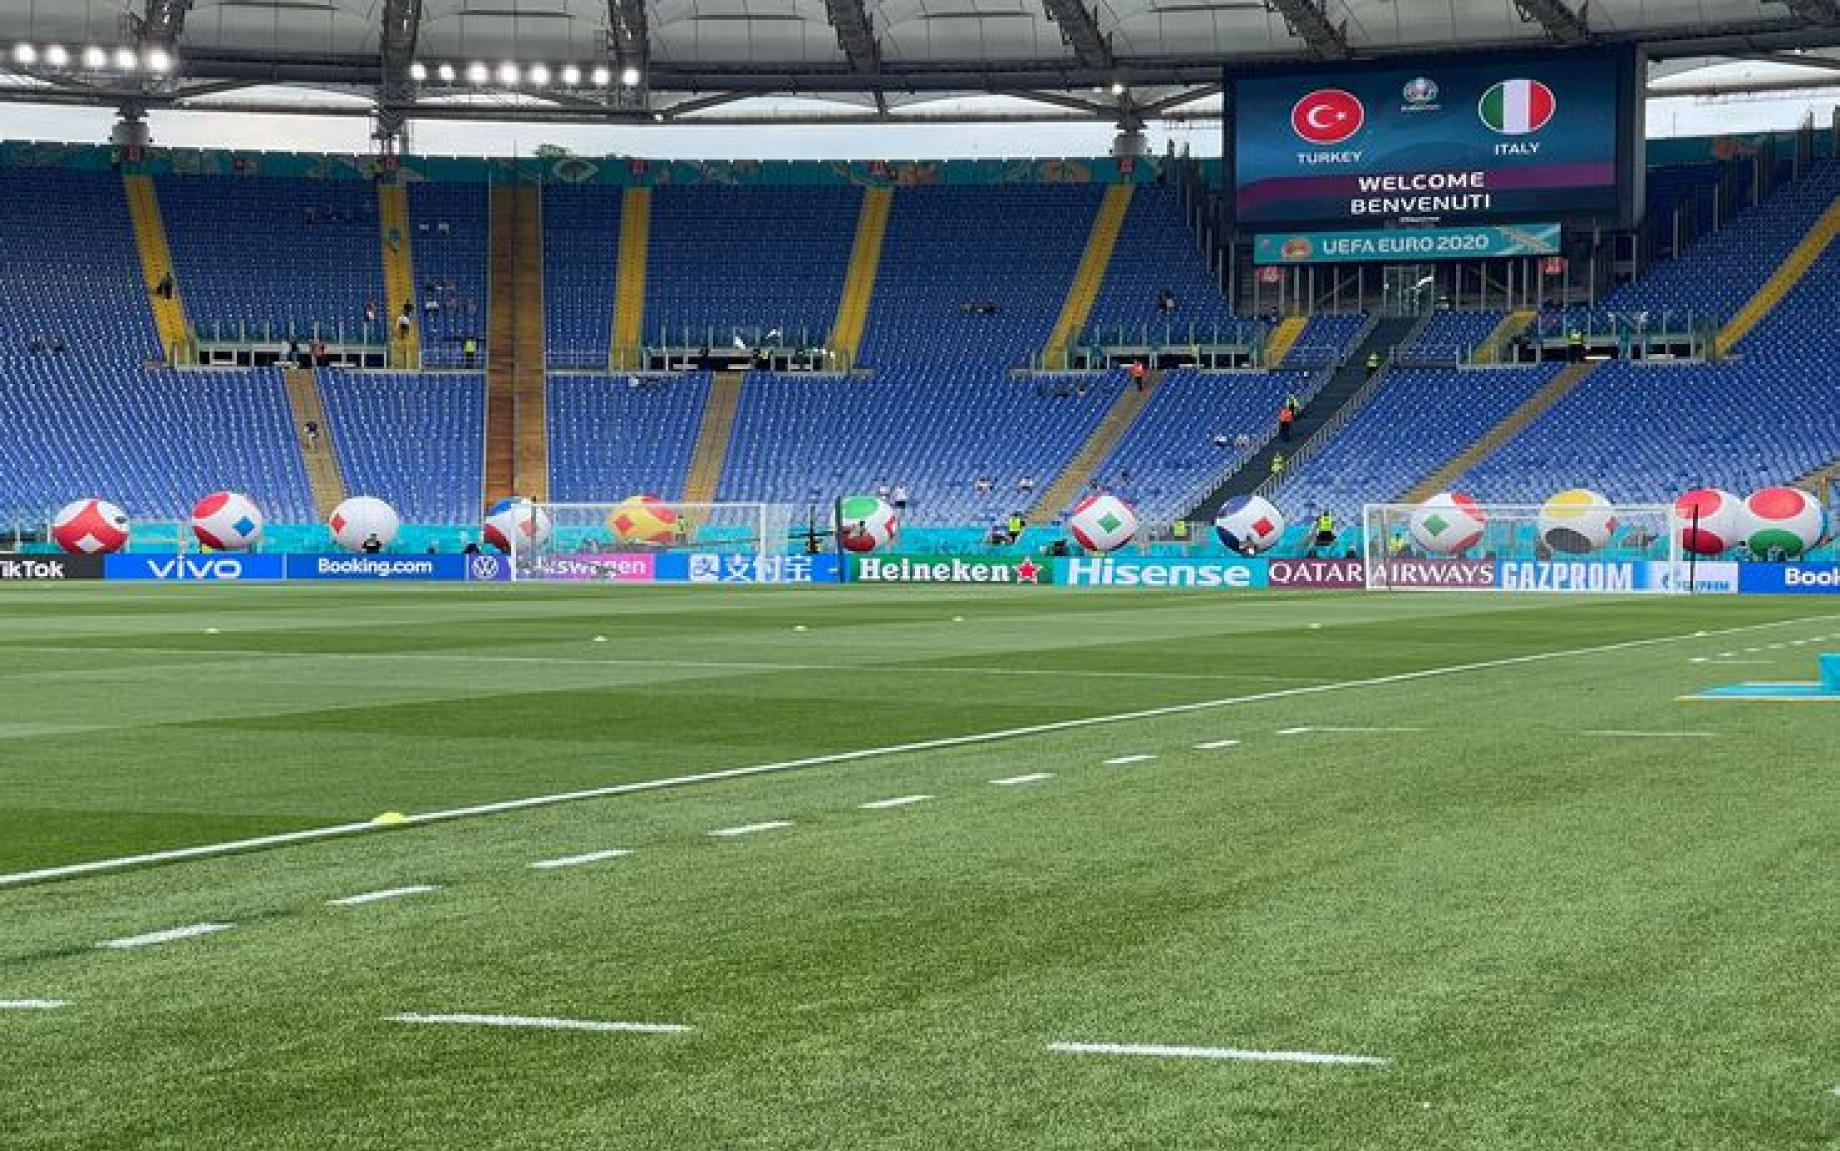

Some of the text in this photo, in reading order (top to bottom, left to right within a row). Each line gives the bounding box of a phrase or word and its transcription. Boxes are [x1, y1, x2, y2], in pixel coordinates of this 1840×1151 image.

[1297, 151, 1363, 164] TURKEY
[1494, 142, 1540, 156] ITALY
[1358, 171, 1485, 192] WELCOME
[1350, 193, 1491, 215] BENVENUTI
[1322, 234, 1489, 256] UEFA EURO 2020
[146, 554, 242, 579] vivo
[318, 558, 432, 577] Booking.com
[858, 558, 1009, 581] Heineken
[1068, 559, 1251, 587] Hisense
[1268, 561, 1495, 584] QATAR AIRWAYS
[1502, 563, 1633, 590] GAZPROM
